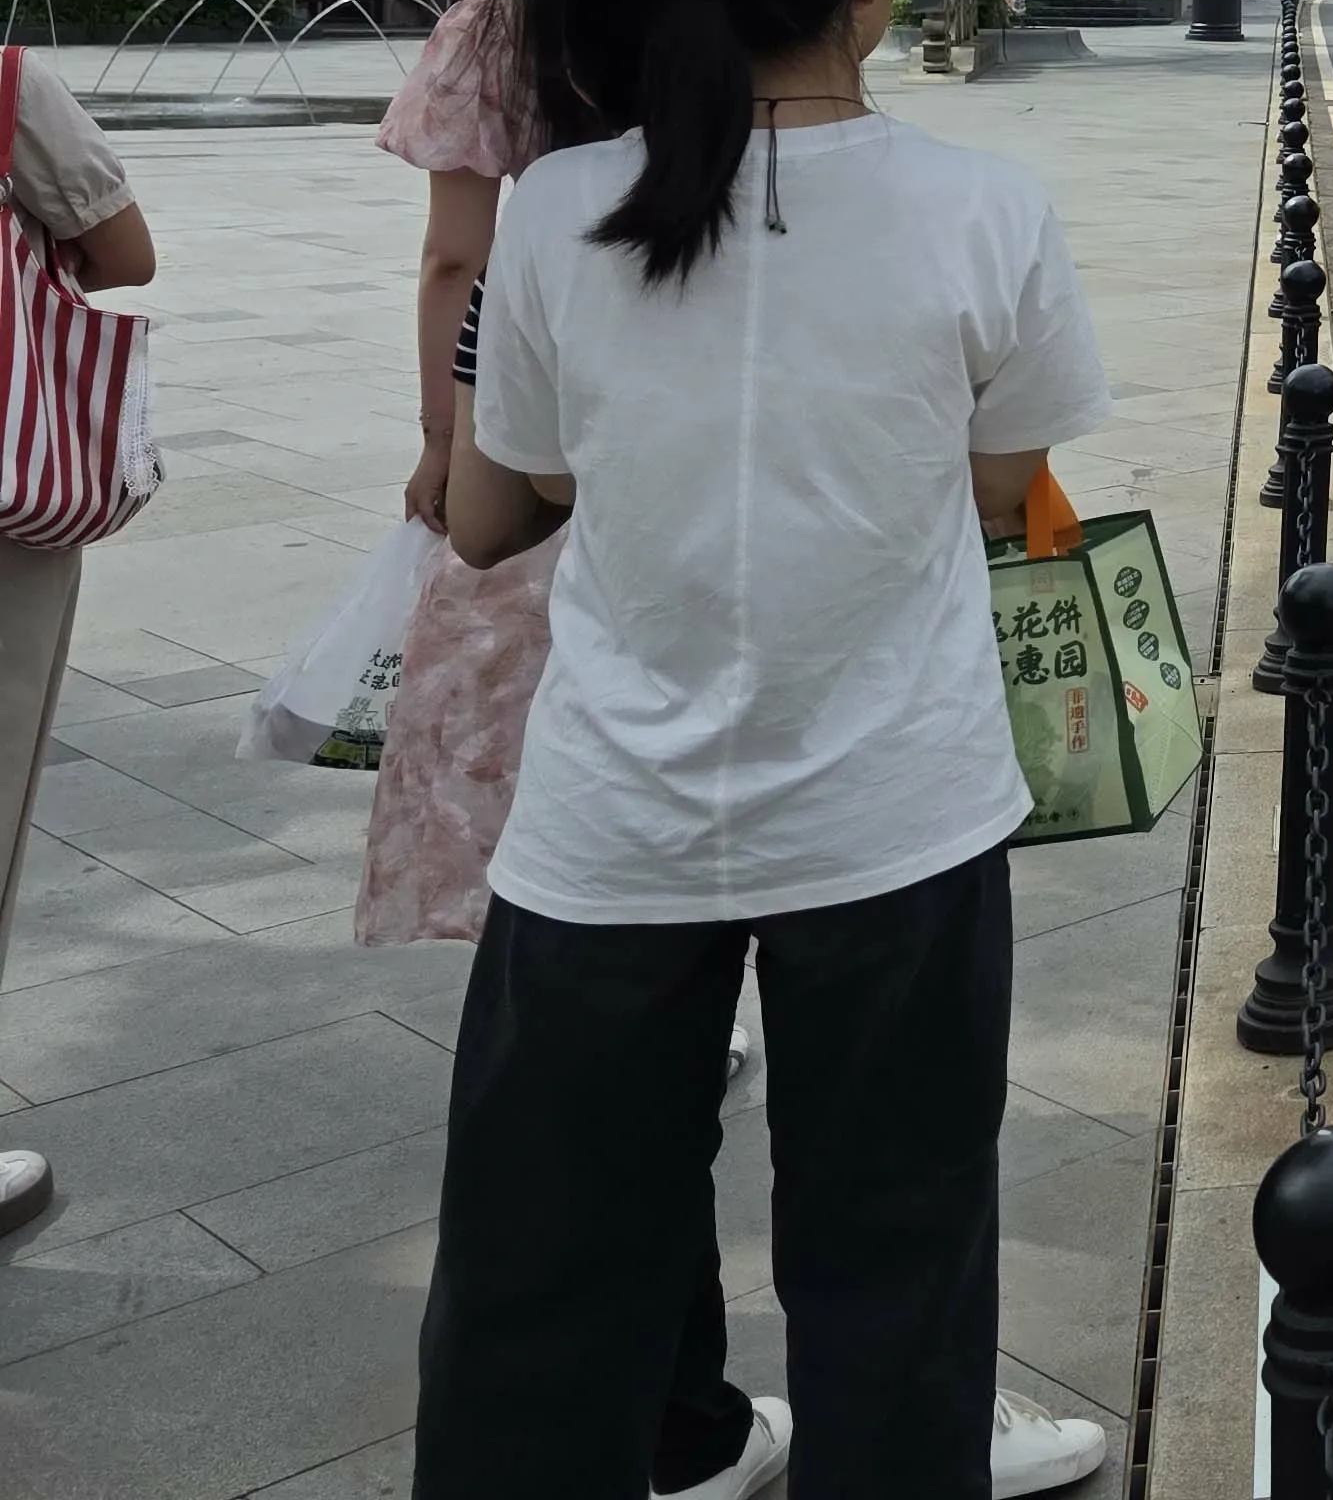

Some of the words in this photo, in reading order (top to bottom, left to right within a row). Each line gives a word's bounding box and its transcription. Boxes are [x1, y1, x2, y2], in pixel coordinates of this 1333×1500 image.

[1000, 640, 1087, 686] 惠园
[1070, 688, 1086, 750] 非遗手作
